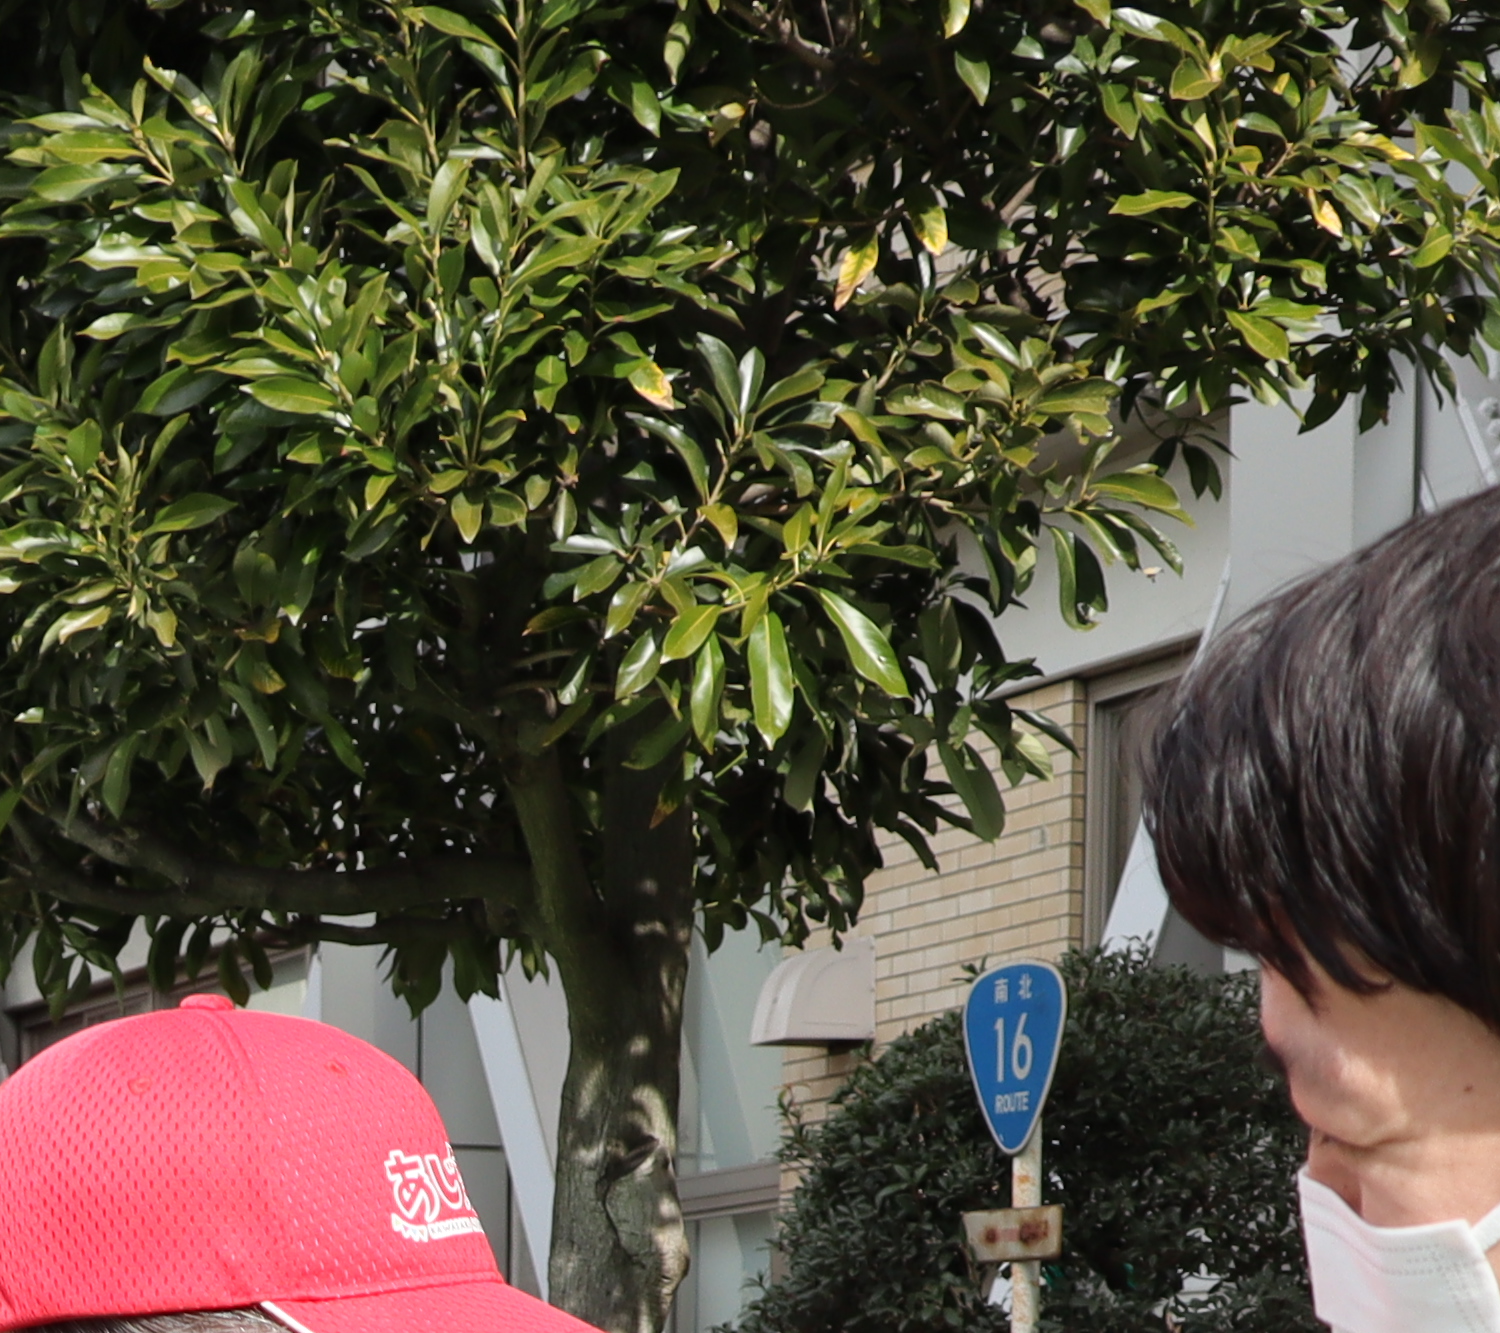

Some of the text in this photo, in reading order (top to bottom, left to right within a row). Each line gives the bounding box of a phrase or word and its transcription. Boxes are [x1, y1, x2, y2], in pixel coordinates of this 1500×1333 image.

[994, 972, 1033, 1004] 南北
[993, 1012, 1033, 1083] 16
[994, 1090, 1030, 1115] ROUTE
[430, 1221, 471, 1235] KAWASAK
